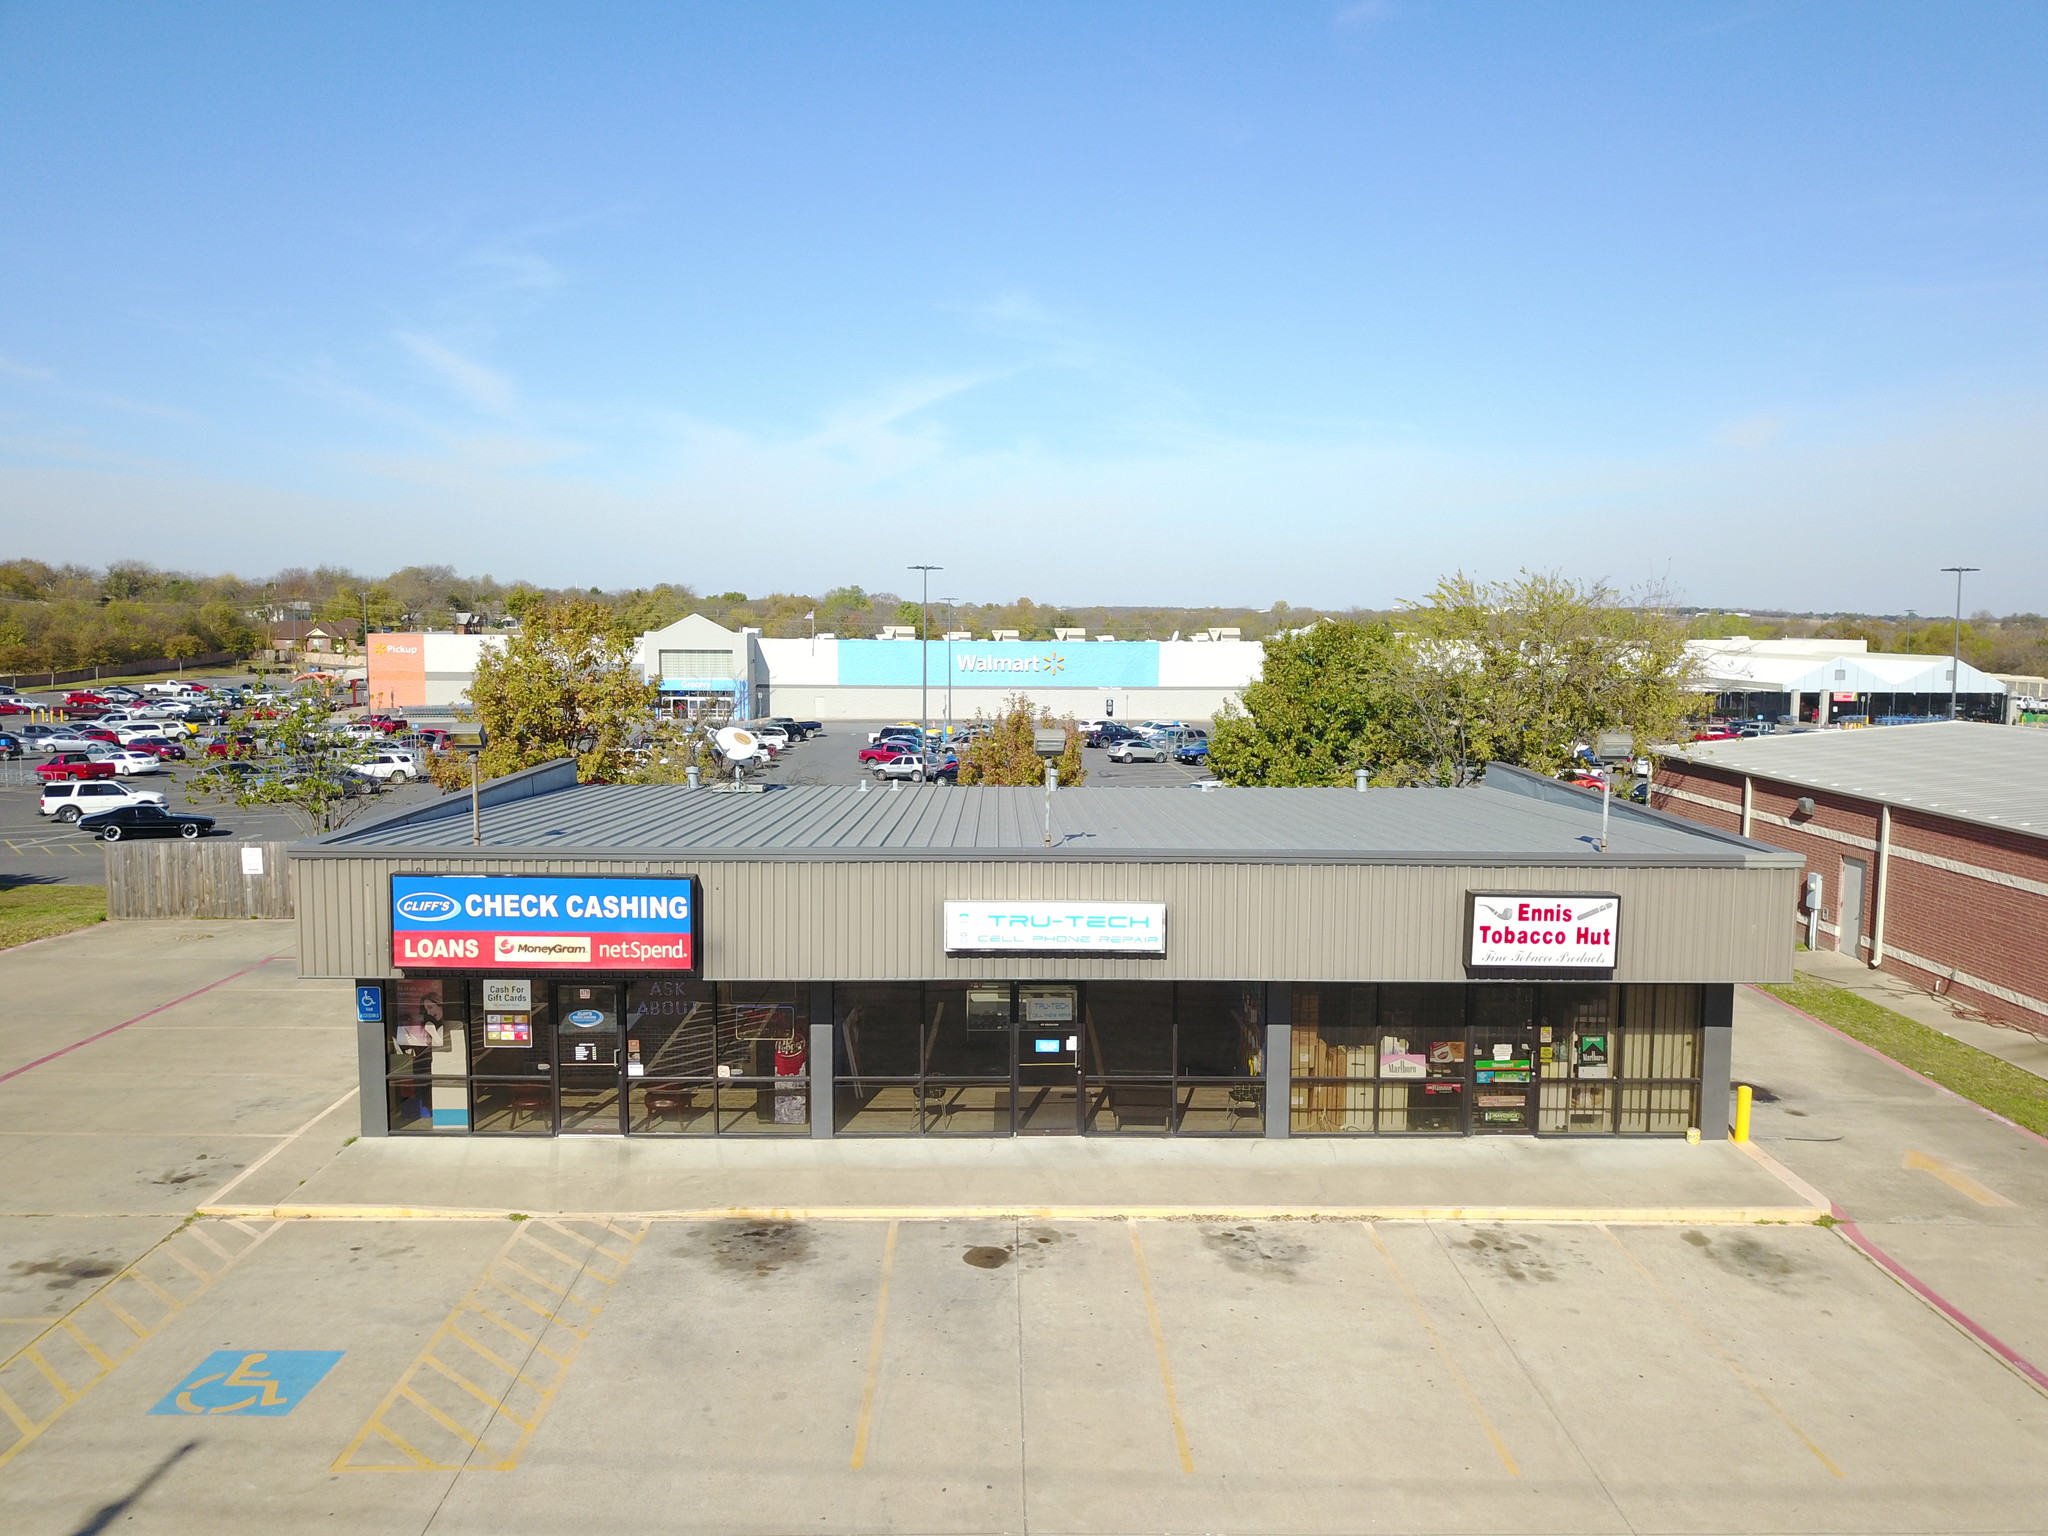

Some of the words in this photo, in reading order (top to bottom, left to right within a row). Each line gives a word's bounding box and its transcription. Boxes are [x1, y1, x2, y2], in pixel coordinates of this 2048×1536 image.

[387, 644, 418, 655] Pickup
[956, 654, 1041, 673] Walmart
[681, 680, 711, 689] Grocery
[402, 900, 451, 912] CLIFF'S
[465, 894, 559, 918] CHECK
[566, 895, 688, 920] CASHING
[1518, 903, 1573, 923] Ennis
[988, 915, 1150, 928] TRU-TECH
[978, 935, 1024, 943] CELL
[1033, 935, 1091, 943] PHONE
[1099, 936, 1159, 944] REPAIR
[1479, 926, 1566, 945] Tobacco
[1576, 927, 1610, 946] Hut
[404, 939, 479, 958] LOANS
[1481, 950, 1508, 962] Fine
[1511, 951, 1554, 963] Tobacco
[1556, 951, 1606, 964] Products
[490, 985, 510, 994] Cash
[511, 985, 525, 994] For
[650, 981, 686, 996] ASK
[487, 993, 503, 1002] Gift
[504, 994, 527, 1002] Cards
[637, 1000, 698, 1015] ABOUT
[1034, 1002, 1071, 1010] TRU-TECH
[1582, 1051, 1604, 1061] Marlboro
[1388, 1060, 1417, 1074] Marlboro
